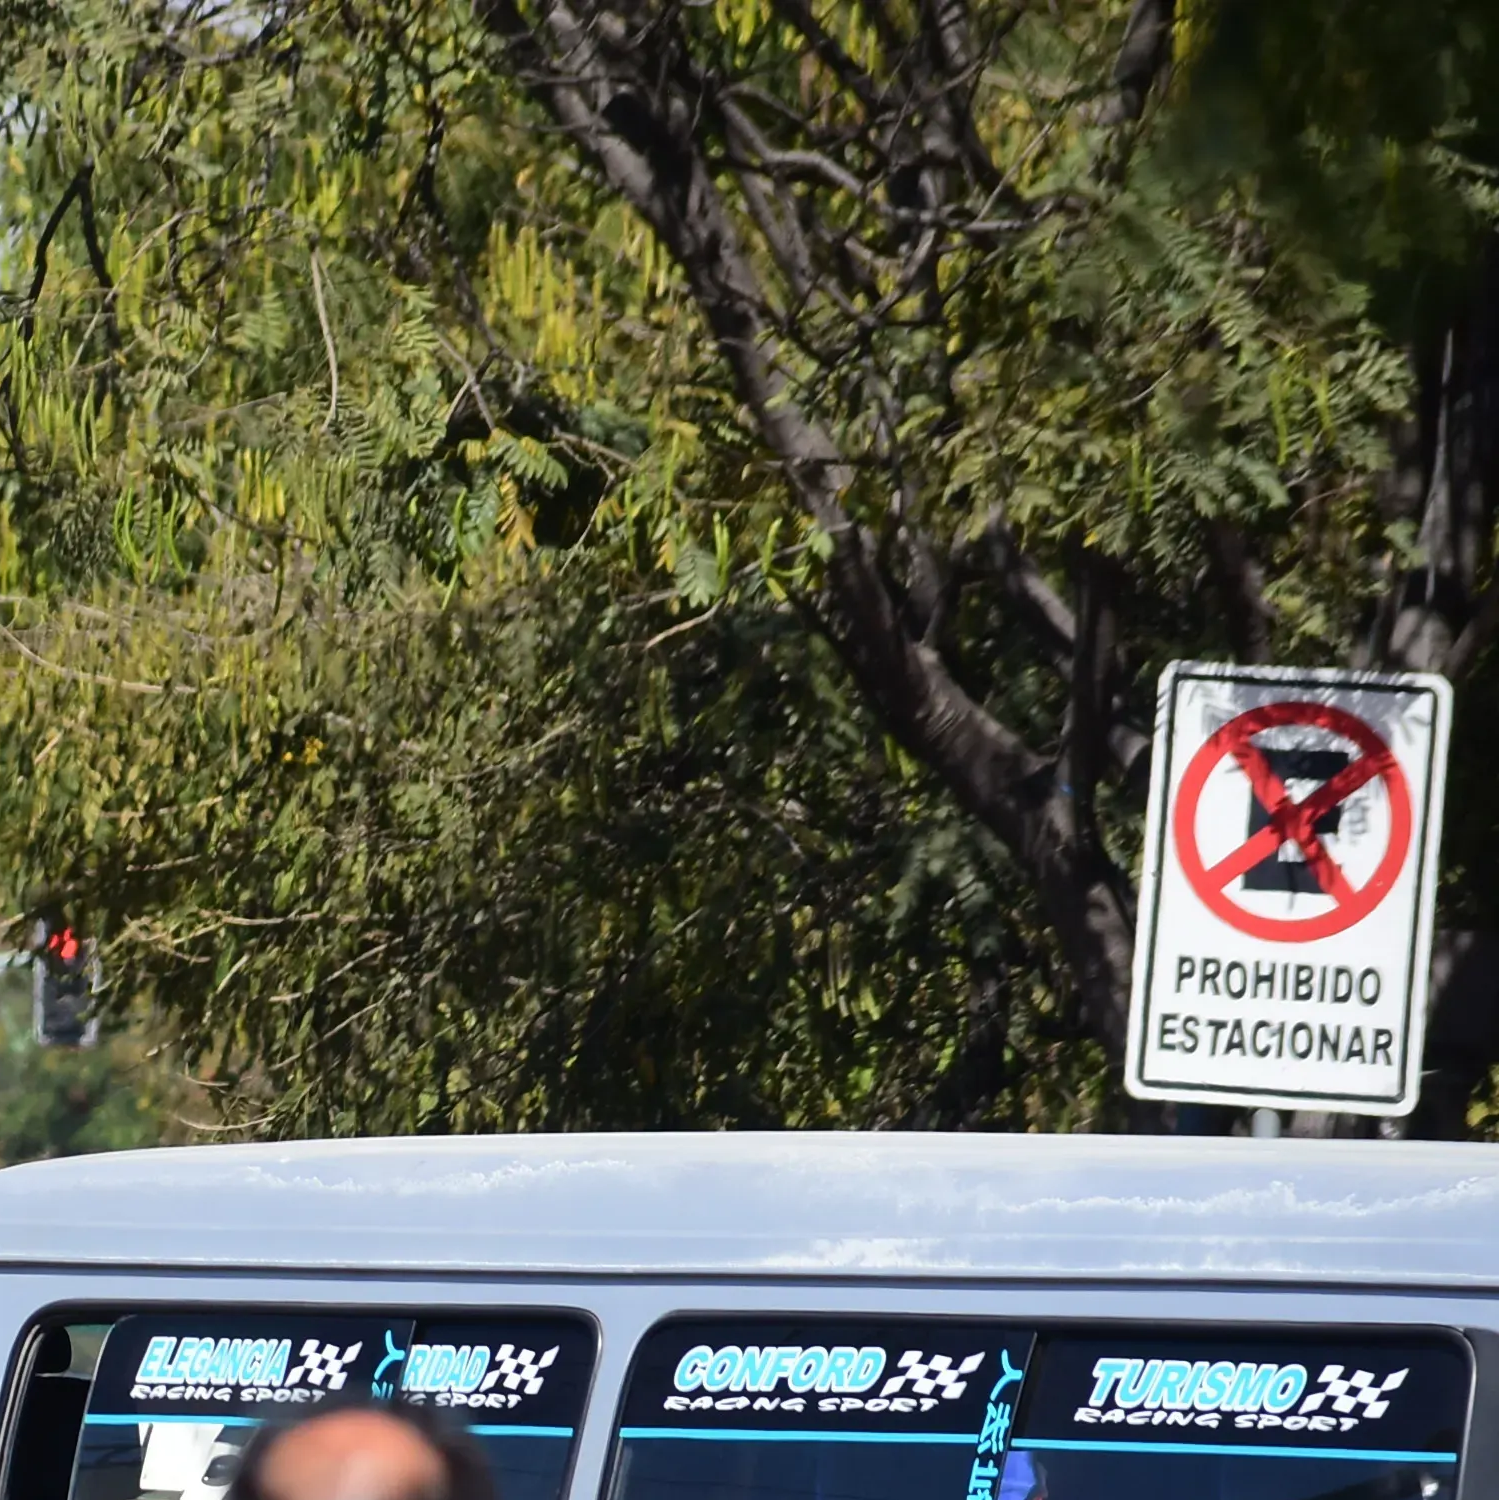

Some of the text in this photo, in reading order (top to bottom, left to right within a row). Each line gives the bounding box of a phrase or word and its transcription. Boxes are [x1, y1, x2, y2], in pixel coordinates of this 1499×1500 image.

[1174, 955, 1382, 1006] PROHIBIDO
[1157, 1012, 1394, 1066] ESTACIONAR
[135, 1336, 293, 1385] ELEGANCIA
[674, 1345, 887, 1392] CONFORD
[130, 1384, 326, 1404] RACING SPORT
[435, 1392, 522, 1409] SPORT
[663, 1395, 940, 1412] RACING SPORT
[1088, 1357, 1308, 1413] TURISMO
[1073, 1407, 1360, 1432] RACING SPORT
